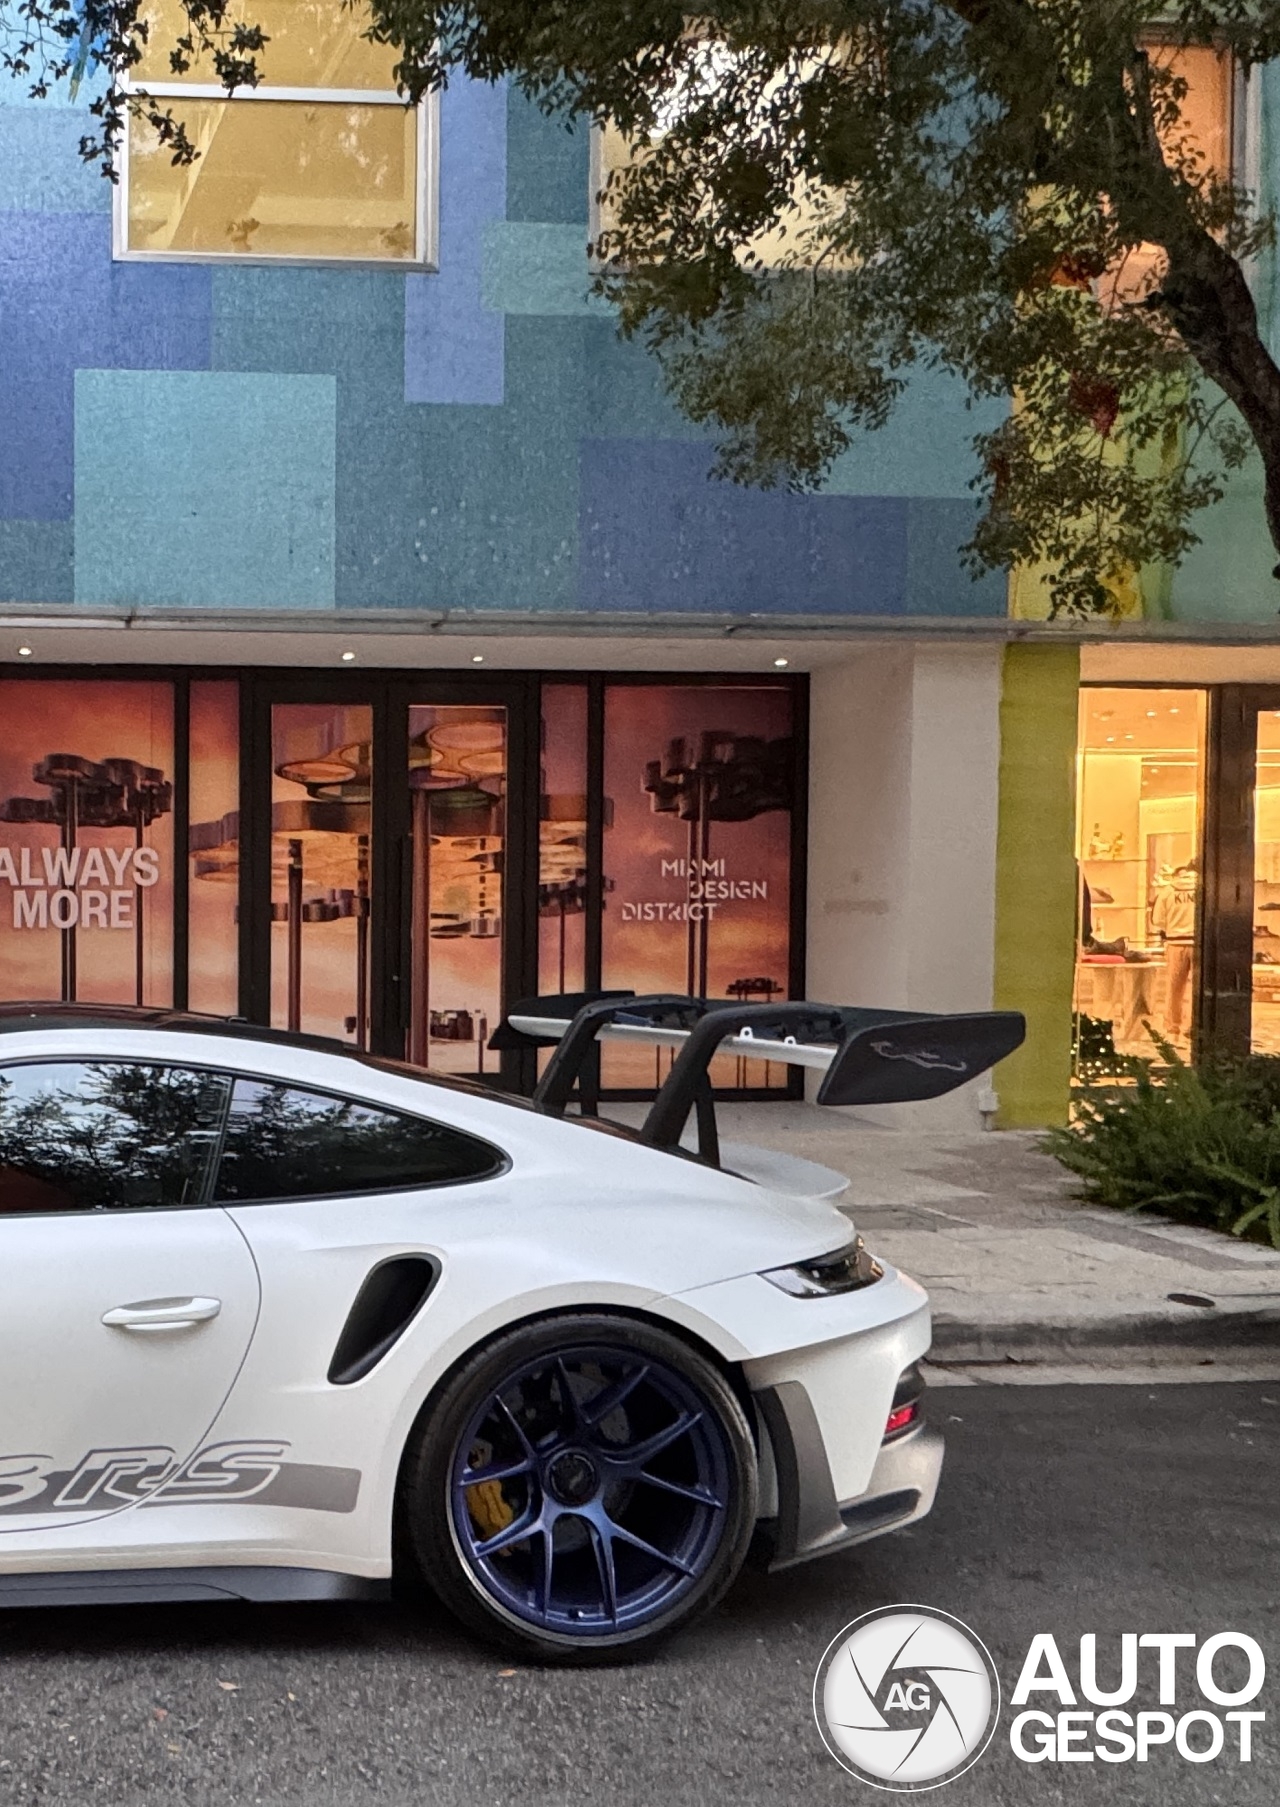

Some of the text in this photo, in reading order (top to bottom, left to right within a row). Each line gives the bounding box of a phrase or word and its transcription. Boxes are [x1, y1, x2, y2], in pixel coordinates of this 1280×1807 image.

[661, 858, 725, 877] MIAMI
[689, 880, 768, 899] DESIGN
[12, 889, 134, 929] MORE
[621, 902, 718, 921] DISTRICT
